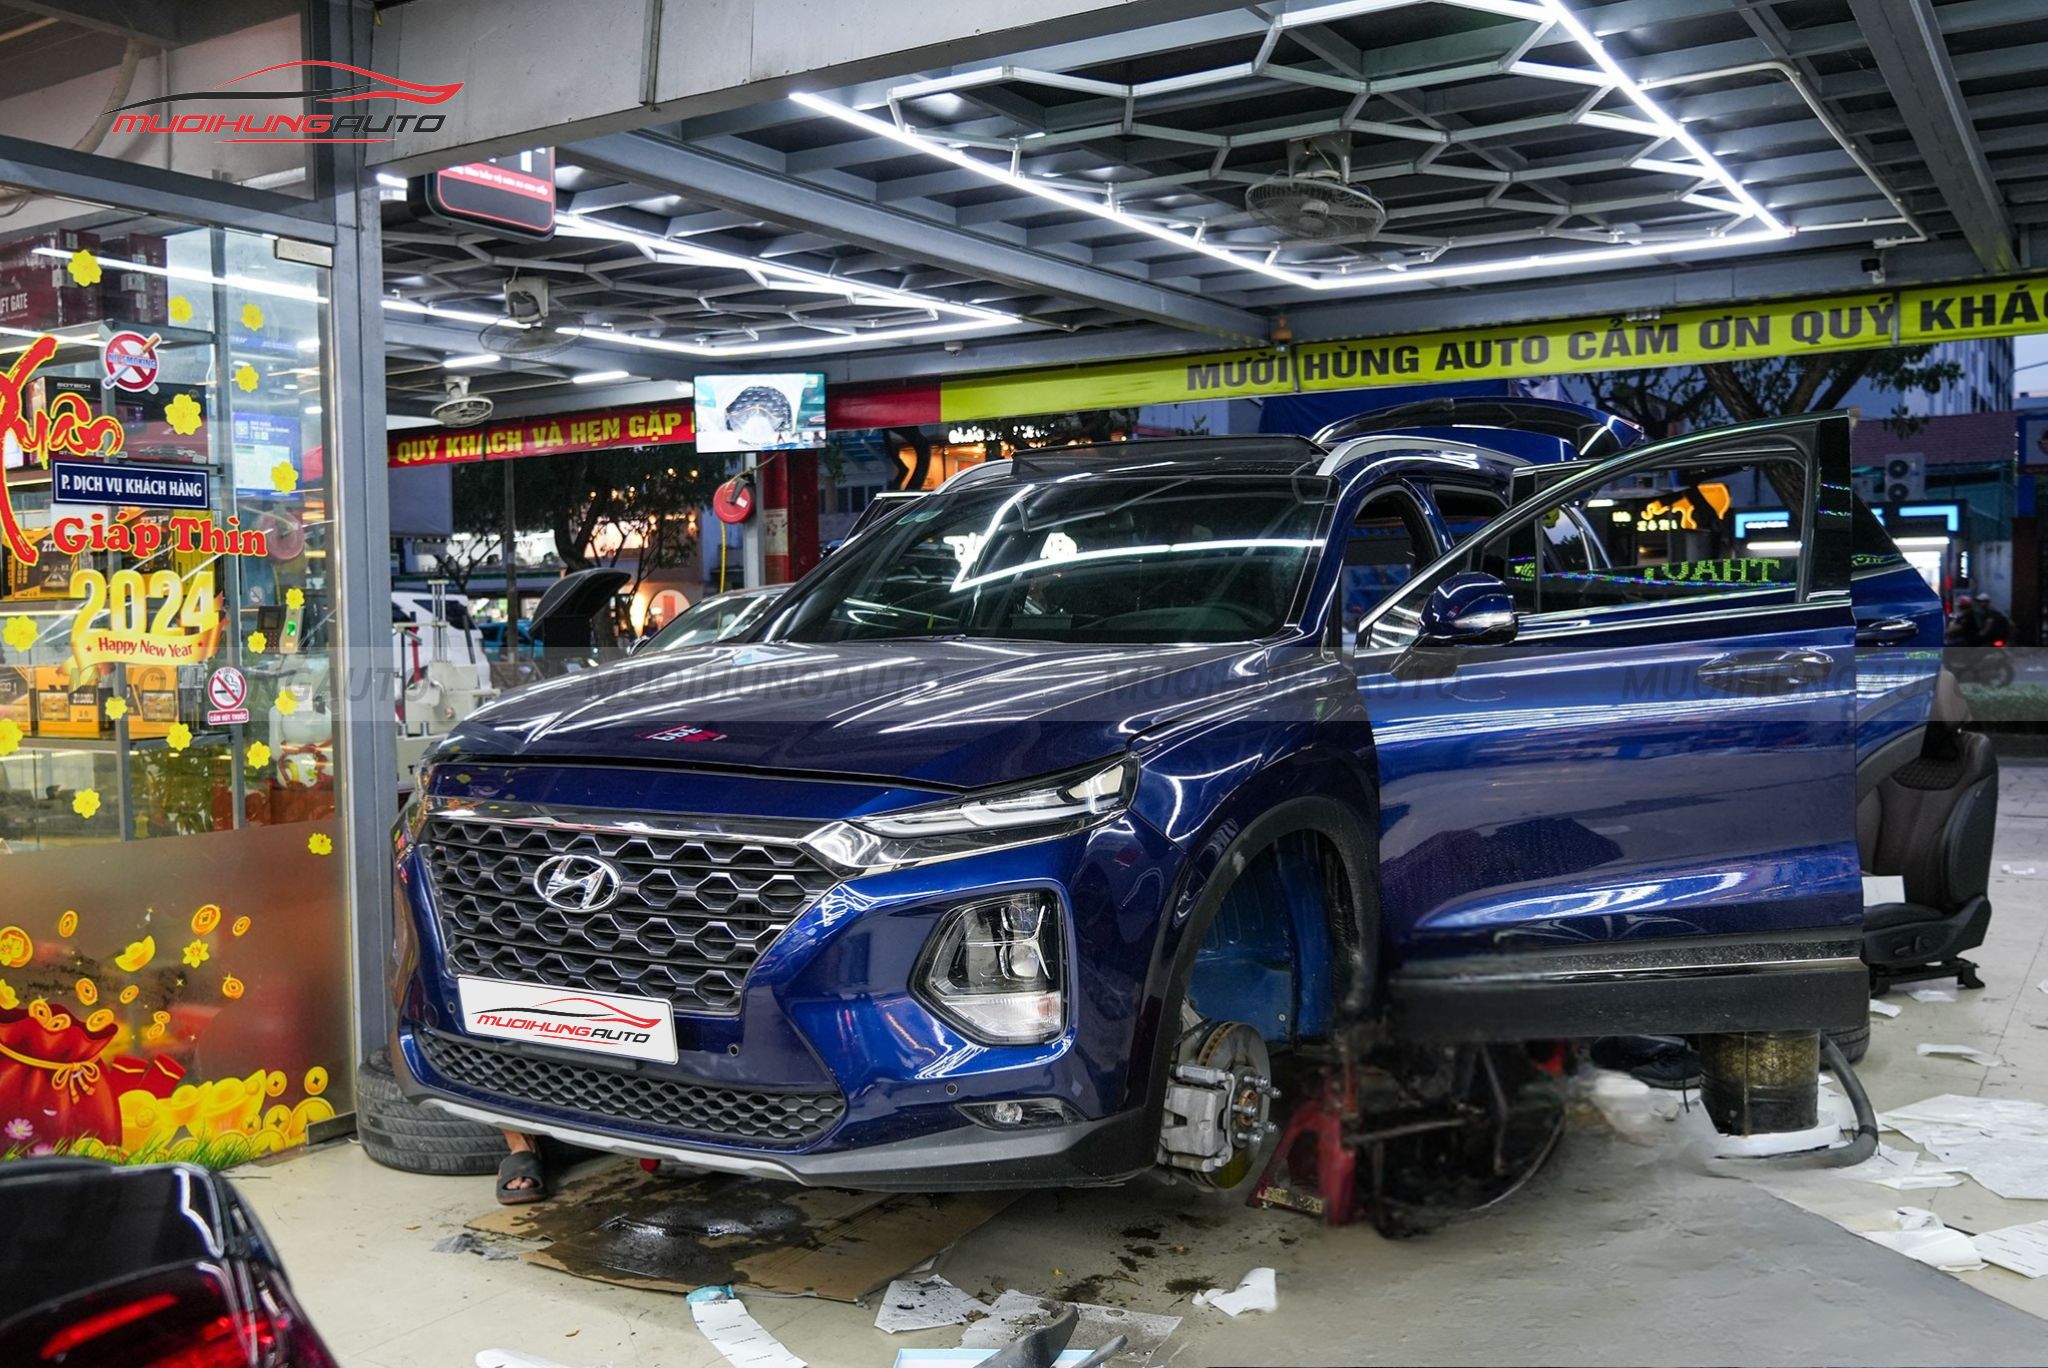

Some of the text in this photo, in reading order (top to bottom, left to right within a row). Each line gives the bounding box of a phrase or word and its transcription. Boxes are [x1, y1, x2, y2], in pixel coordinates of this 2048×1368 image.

[1187, 284, 2048, 391] MƯỜI HÙNG AUTO CẢM ƠN QUÝ KHÁ
[397, 435, 439, 464] QUÝ
[532, 421, 564, 449] VÀ
[570, 417, 620, 447] HẸN
[628, 409, 682, 441] GẶP
[61, 474, 202, 497] P. DỊCH VỤ KHÁCH HÀNG
[53, 511, 269, 558] Giáp Thìn
[69, 568, 219, 637] 2024
[98, 637, 193, 658] Happy New Year
